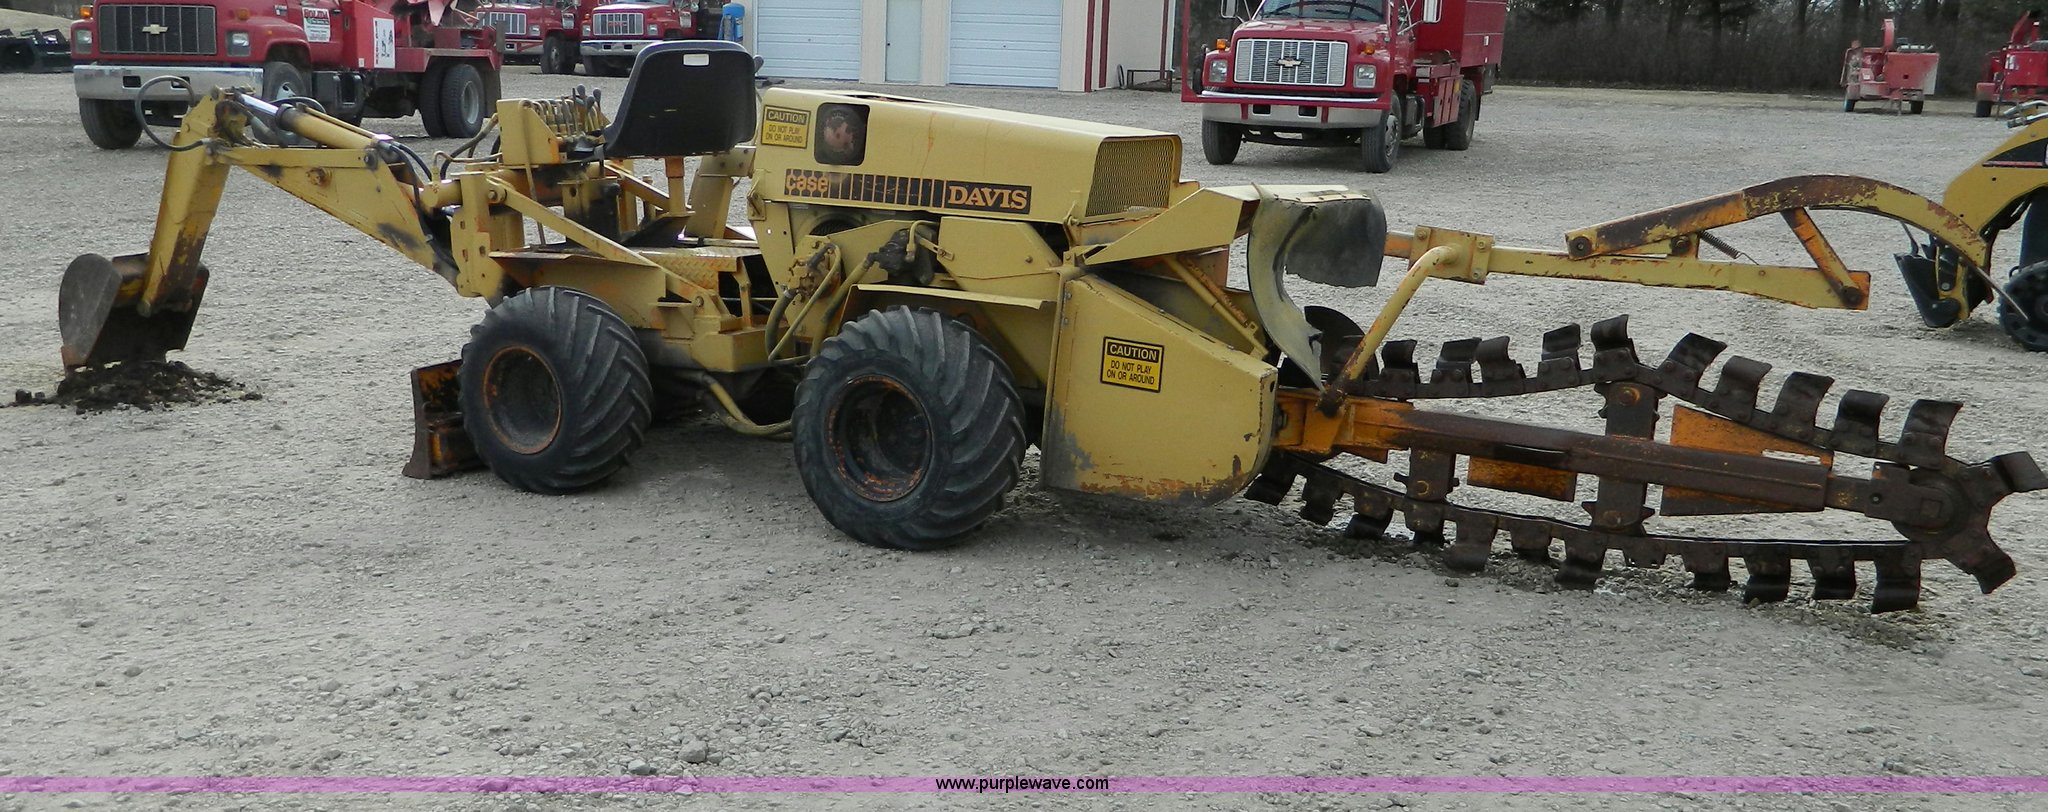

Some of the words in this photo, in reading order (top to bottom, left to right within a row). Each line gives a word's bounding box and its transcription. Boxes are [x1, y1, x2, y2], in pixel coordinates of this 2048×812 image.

[768, 110, 807, 123] CAUTION
[769, 124, 776, 132] DO
[778, 125, 788, 133] NOT
[948, 185, 1028, 210] DAVIS
[1109, 344, 1157, 361] CAUTION
[1111, 360, 1120, 370] DO
[1122, 362, 1135, 371] NOT
[1137, 364, 1152, 374] PLAY
[1106, 369, 1116, 378] ON
[1118, 371, 1127, 380] OR
[1129, 373, 1155, 385] AROUND
